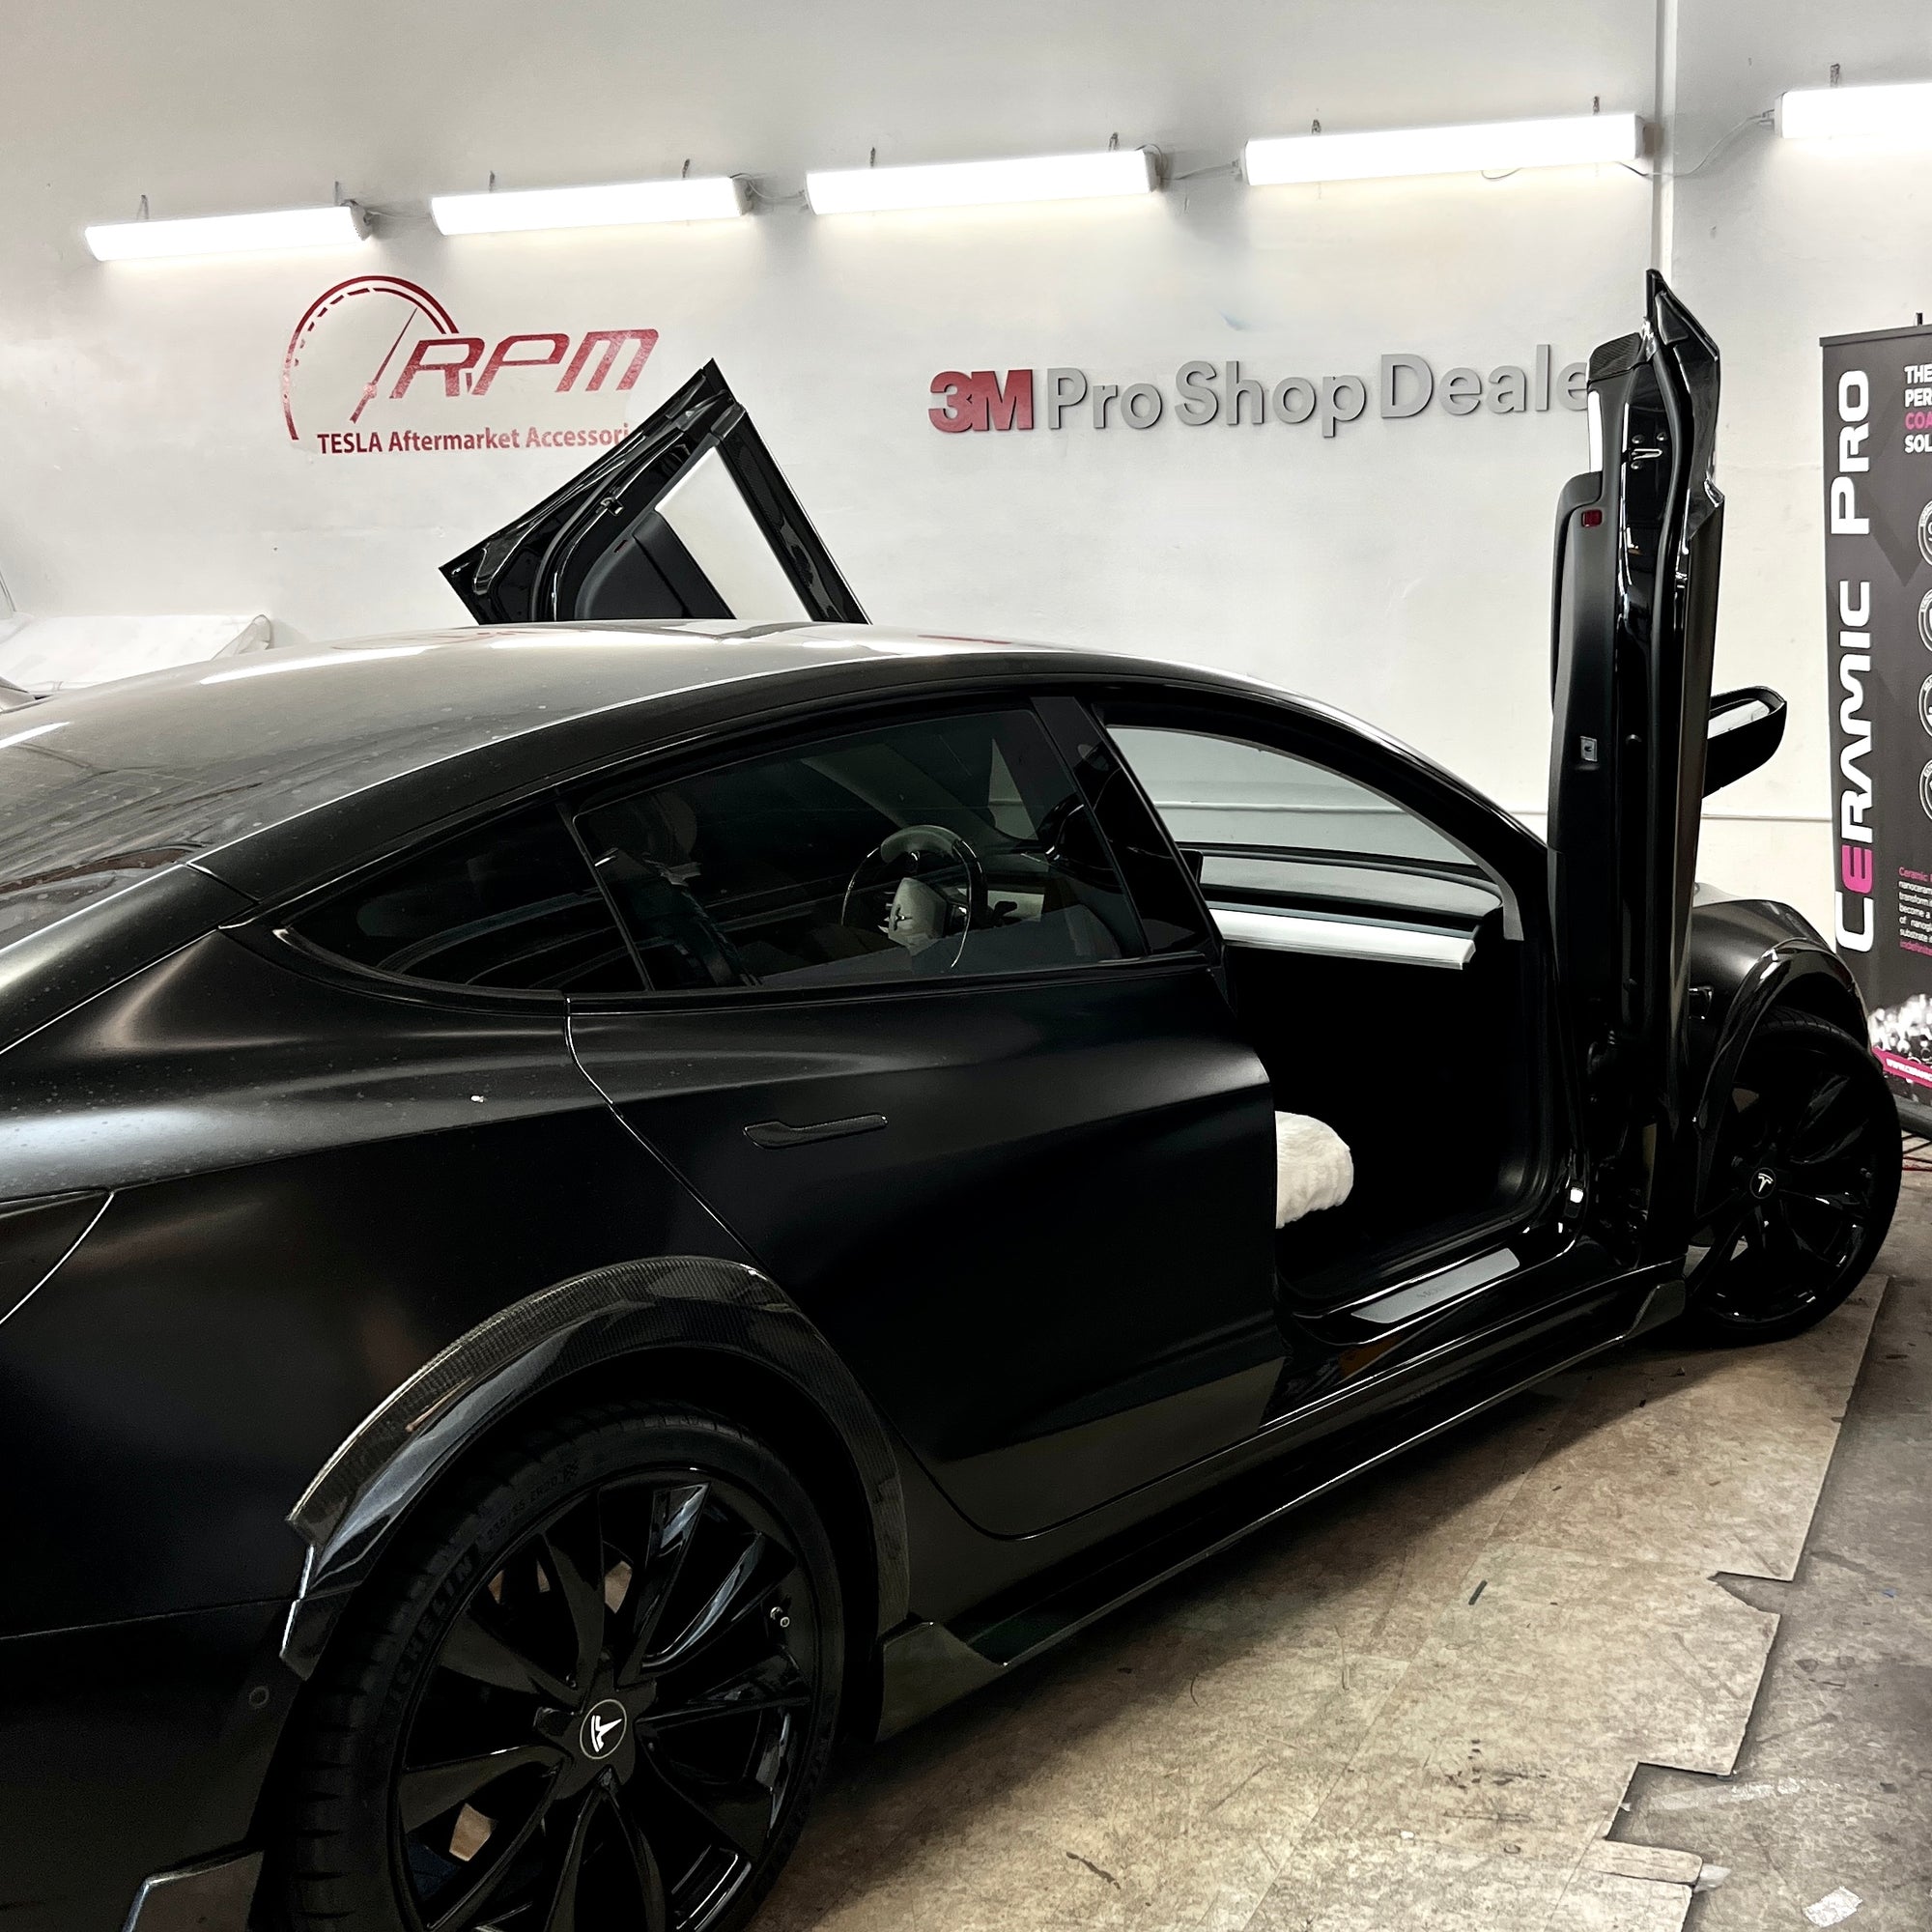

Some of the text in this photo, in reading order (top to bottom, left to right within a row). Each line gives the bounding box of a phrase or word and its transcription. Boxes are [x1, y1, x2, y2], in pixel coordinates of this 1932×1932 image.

[388, 328, 659, 398] RPM
[1904, 364, 1932, 384] THE
[928, 368, 1034, 434] 3M
[1046, 367, 1165, 431] Pro
[1175, 360, 1368, 440] Shop
[317, 432, 384, 455] TESLA
[387, 425, 520, 453] Aftermarket
[1832, 371, 1874, 952] CERAMIC PRO
